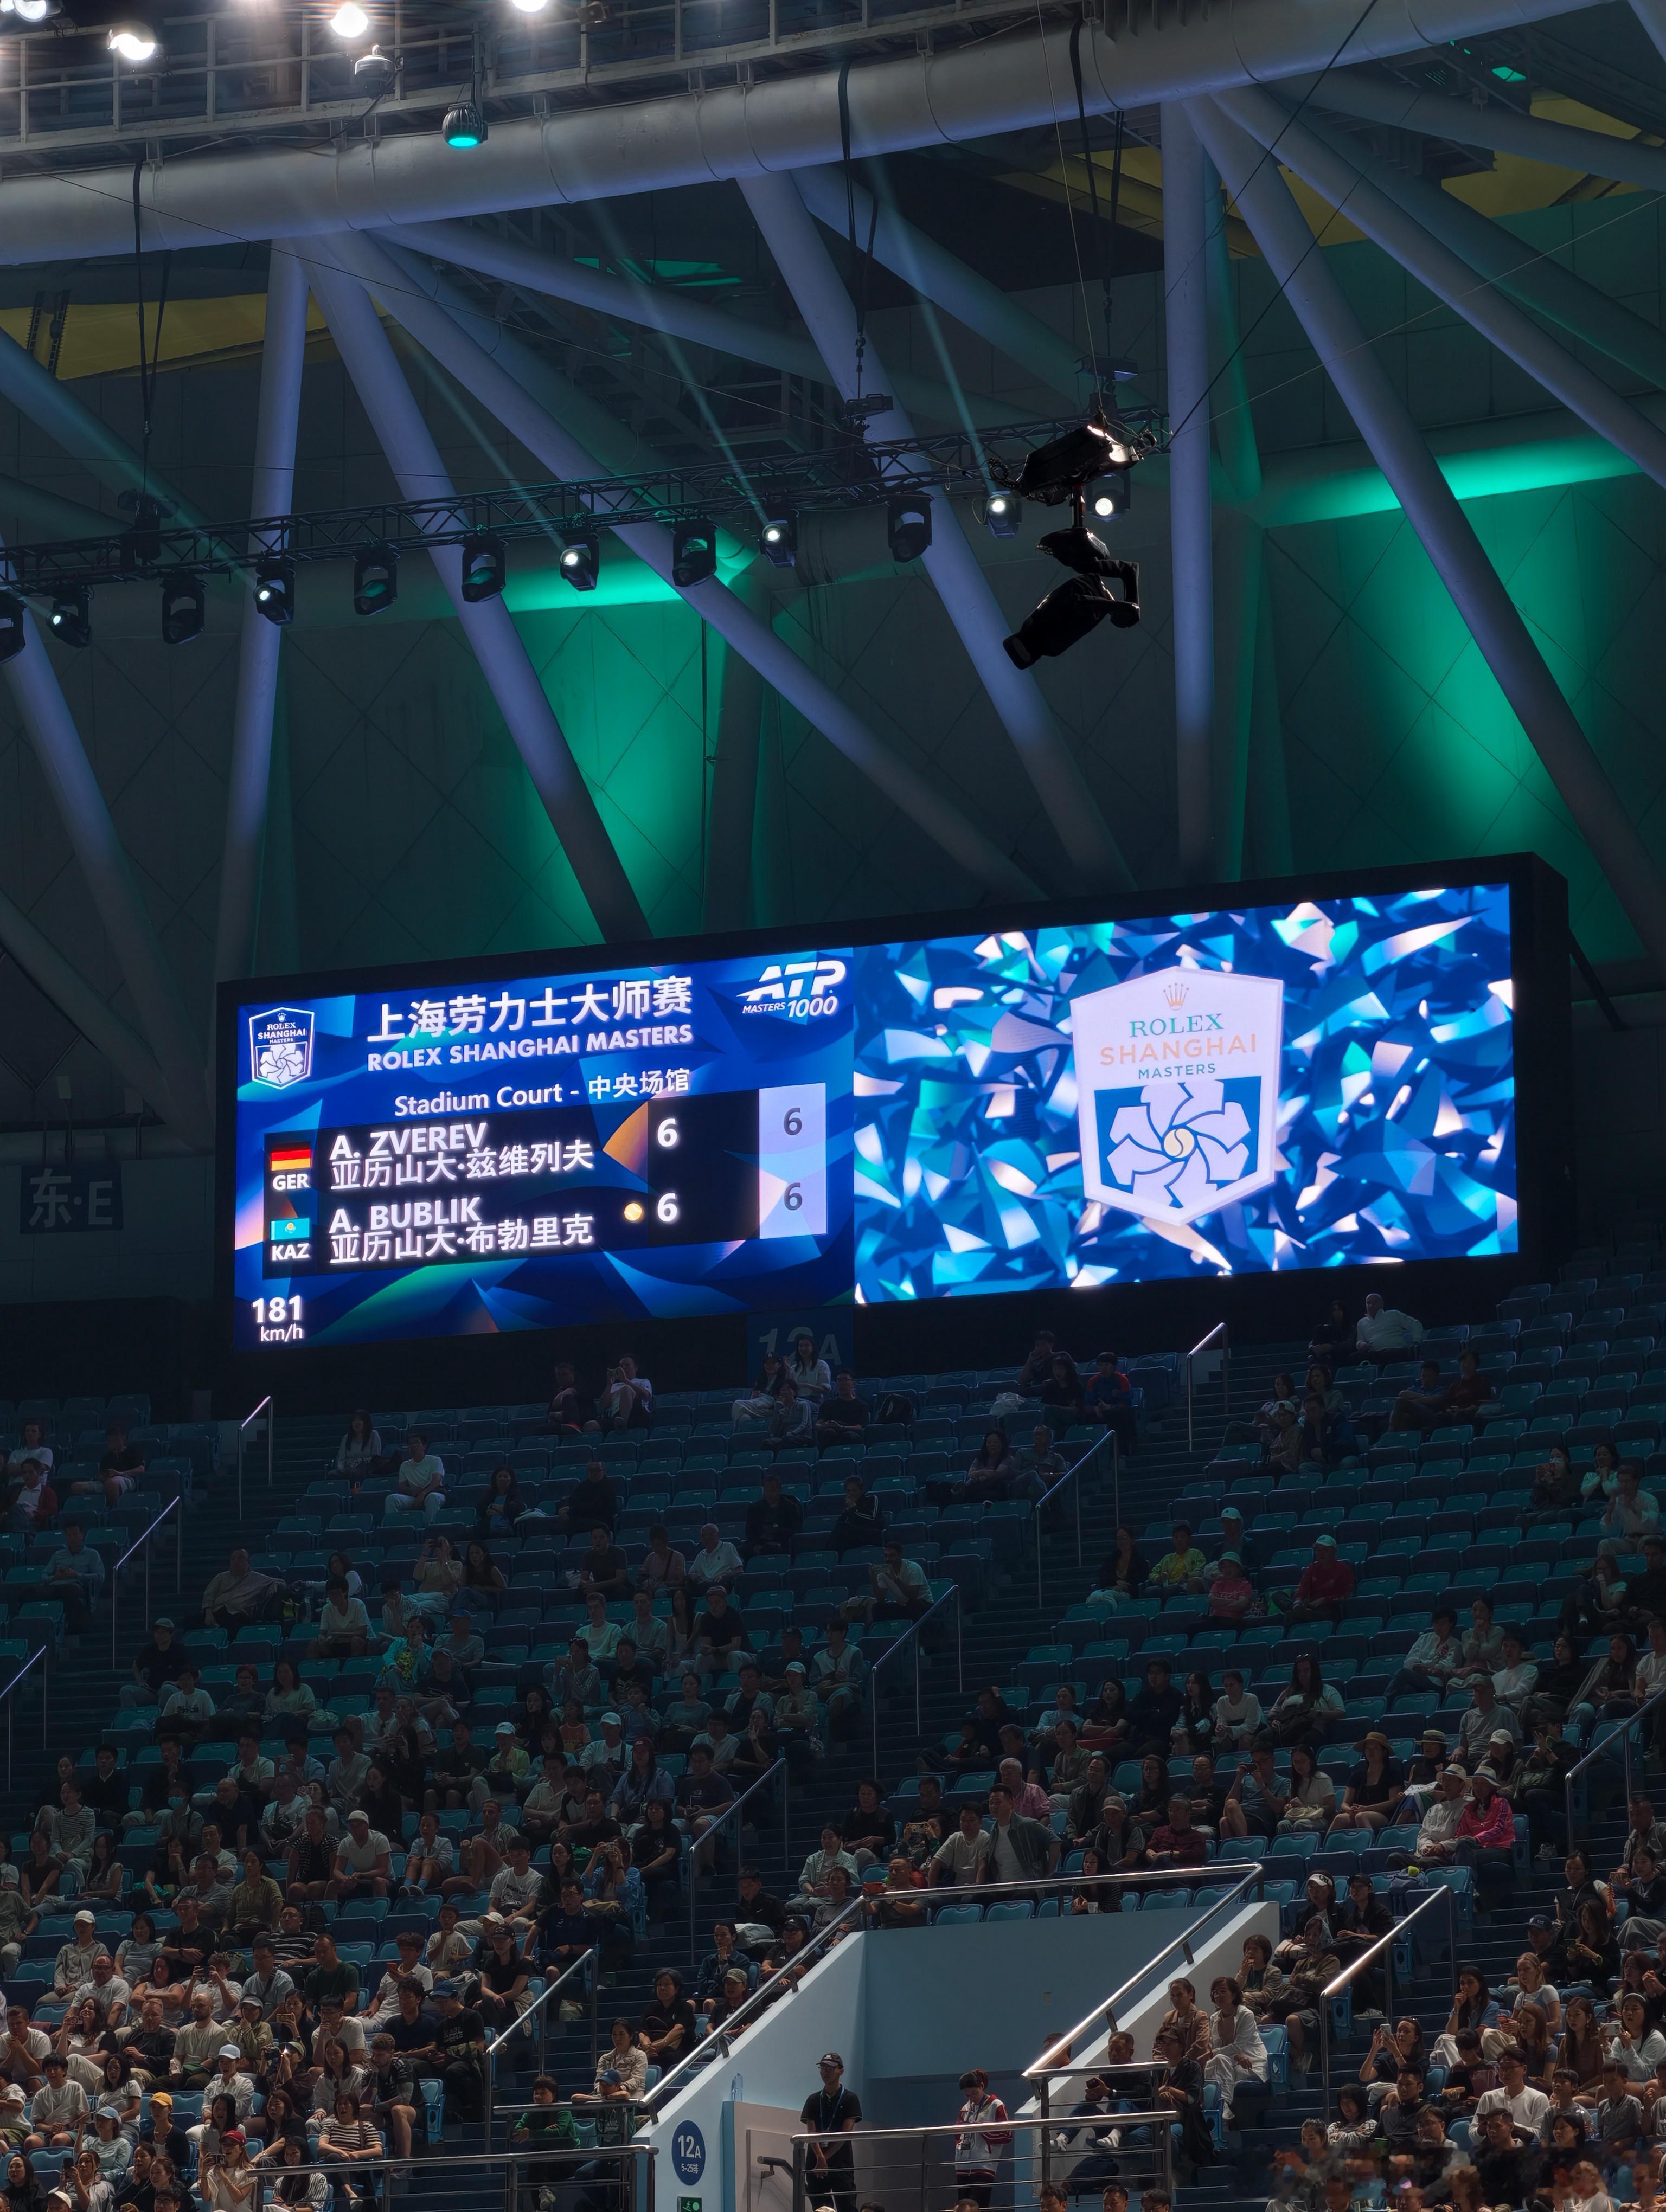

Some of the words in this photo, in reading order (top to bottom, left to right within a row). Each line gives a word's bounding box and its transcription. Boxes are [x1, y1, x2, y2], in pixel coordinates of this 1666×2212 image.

[736, 960, 846, 1001] ATP
[367, 975, 692, 1043] 上海劳力士大师赛
[742, 1002, 786, 1014] MASTERS
[787, 995, 838, 1018] 1000
[258, 1028, 306, 1040] SHANGHAI
[266, 1022, 297, 1031] ROLEX
[1129, 1013, 1225, 1038] ROLEX
[368, 1047, 443, 1072] ROLEX
[450, 1035, 578, 1063] SHANGHAI
[586, 1024, 693, 1052] MASTERS
[1099, 1033, 1257, 1066] SHANGHAI
[1138, 1063, 1216, 1080] MASTERS
[395, 1091, 490, 1117] Stadium
[496, 1084, 562, 1107] Court
[588, 1067, 690, 1100] 中央场馆
[656, 1118, 678, 1148] 6
[783, 1107, 803, 1136] 6
[329, 1135, 360, 1160] A.
[369, 1122, 488, 1158] ZVEREV
[330, 1139, 594, 1191] 亚历山大·兹维列夫
[272, 1173, 309, 1191] GER
[783, 1182, 803, 1211] 6
[329, 1208, 360, 1233] A.
[370, 1197, 482, 1230] BUBLIK
[656, 1193, 678, 1223] 6
[271, 1242, 309, 1261] KAZ
[329, 1213, 593, 1264] 亚历山大·布勃里克
[252, 1294, 302, 1324] 181
[260, 1323, 303, 1343] km/h
[678, 2135, 701, 2158] 12A
